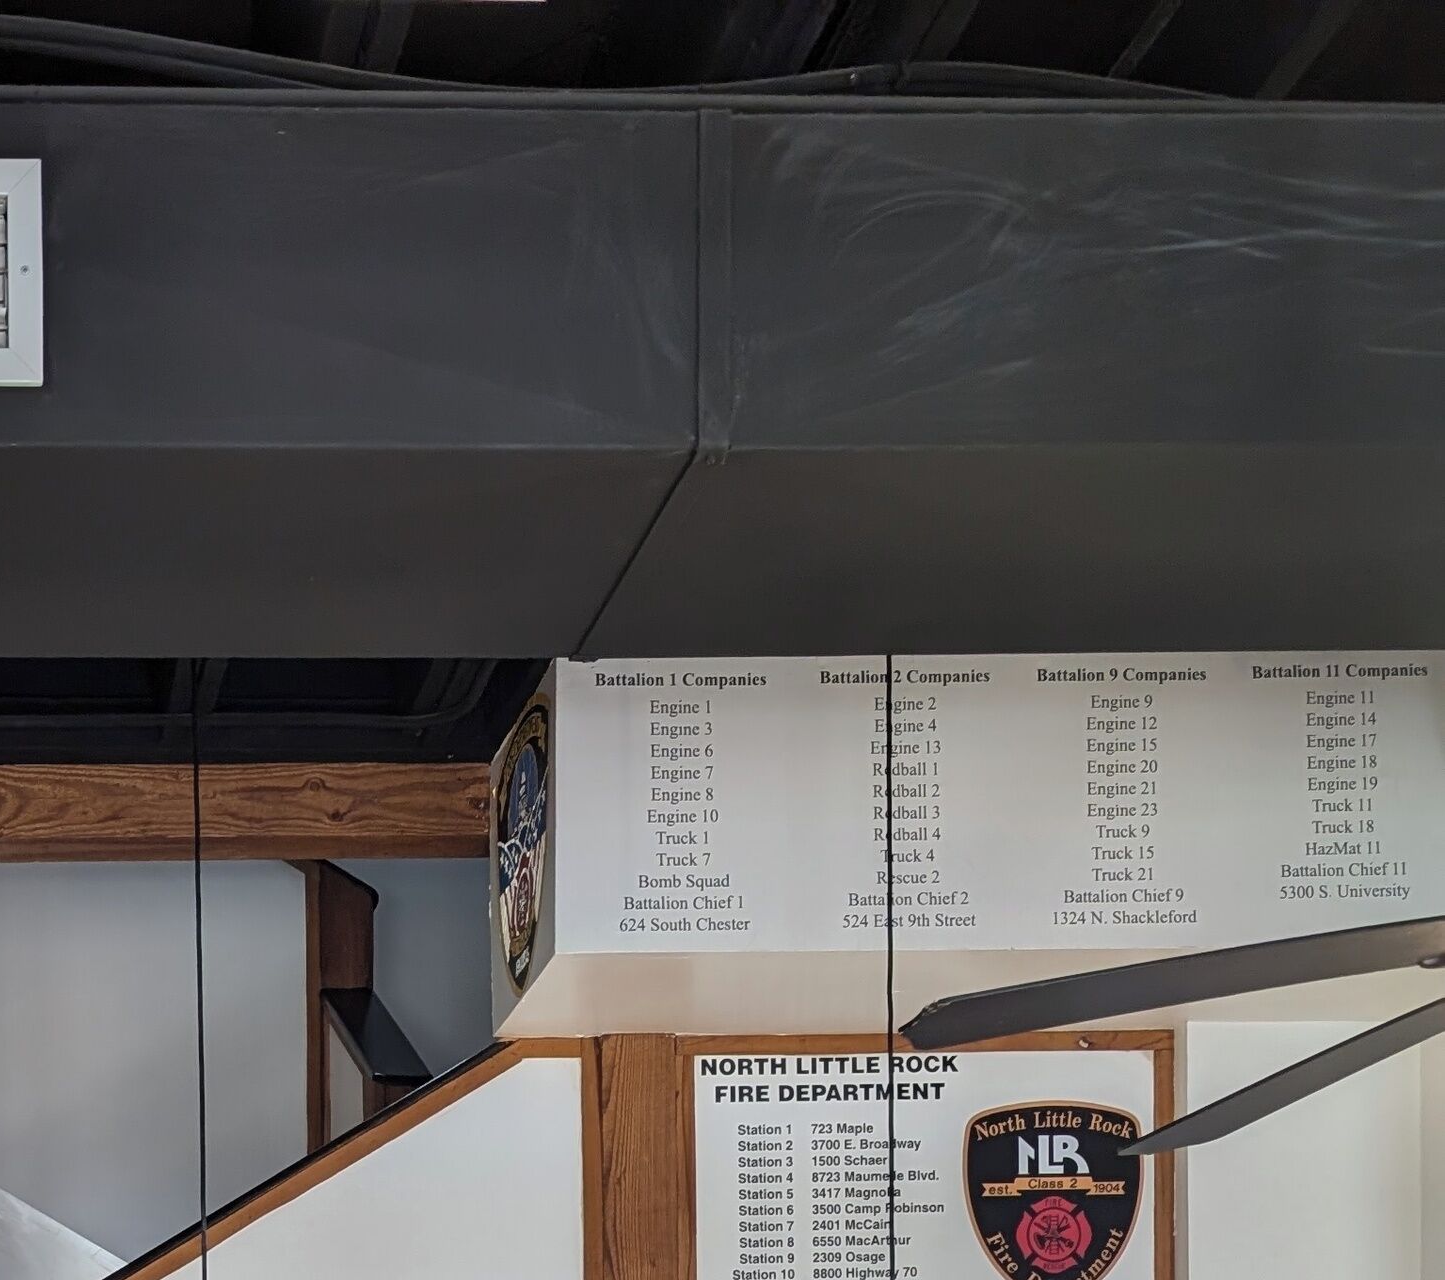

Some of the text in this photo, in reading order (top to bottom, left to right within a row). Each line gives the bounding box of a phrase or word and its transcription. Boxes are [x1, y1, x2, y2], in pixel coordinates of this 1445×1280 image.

[595, 672, 767, 690] Battalion 1 Companies
[1037, 668, 1207, 685] Battalion 9 Companies
[1252, 663, 1428, 681] Battalion 11 Companies
[650, 699, 711, 718] Engine 1
[1306, 690, 1374, 709] Engine 11
[650, 722, 713, 740] Engine 3
[651, 743, 714, 762] Engine 6
[651, 765, 714, 784] Engine 7
[651, 787, 714, 805] Engine 8
[647, 809, 719, 827] Engine 10
[655, 830, 708, 845] Truck 1
[1306, 841, 1381, 856] HazMat 11
[655, 852, 711, 867] Truck 7
[1281, 862, 1406, 878] Battalion Chief 11
[639, 874, 730, 892] Bomb Squad
[1280, 883, 1411, 901] 5300 S. University
[624, 895, 743, 910] Battalion Chief 1
[619, 917, 751, 932] 624 South Chester
[700, 1057, 787, 1076] NORTH
[796, 1056, 881, 1075] LITTLE
[715, 1085, 771, 1103] FIRE
[738, 1123, 874, 1137] Station 1 723 Maple
[974, 1110, 1134, 1141] North Little Rock
[738, 1154, 888, 1168] Station 3 1500 Schaer
[1017, 1134, 1090, 1175] NLR
[1028, 1178, 1064, 1190] Class
[1069, 1178, 1078, 1189] 2
[1093, 1183, 1120, 1193] 1904
[740, 1251, 886, 1265] Station 9 2309 Osage
[986, 1232, 1020, 1275] Fire
